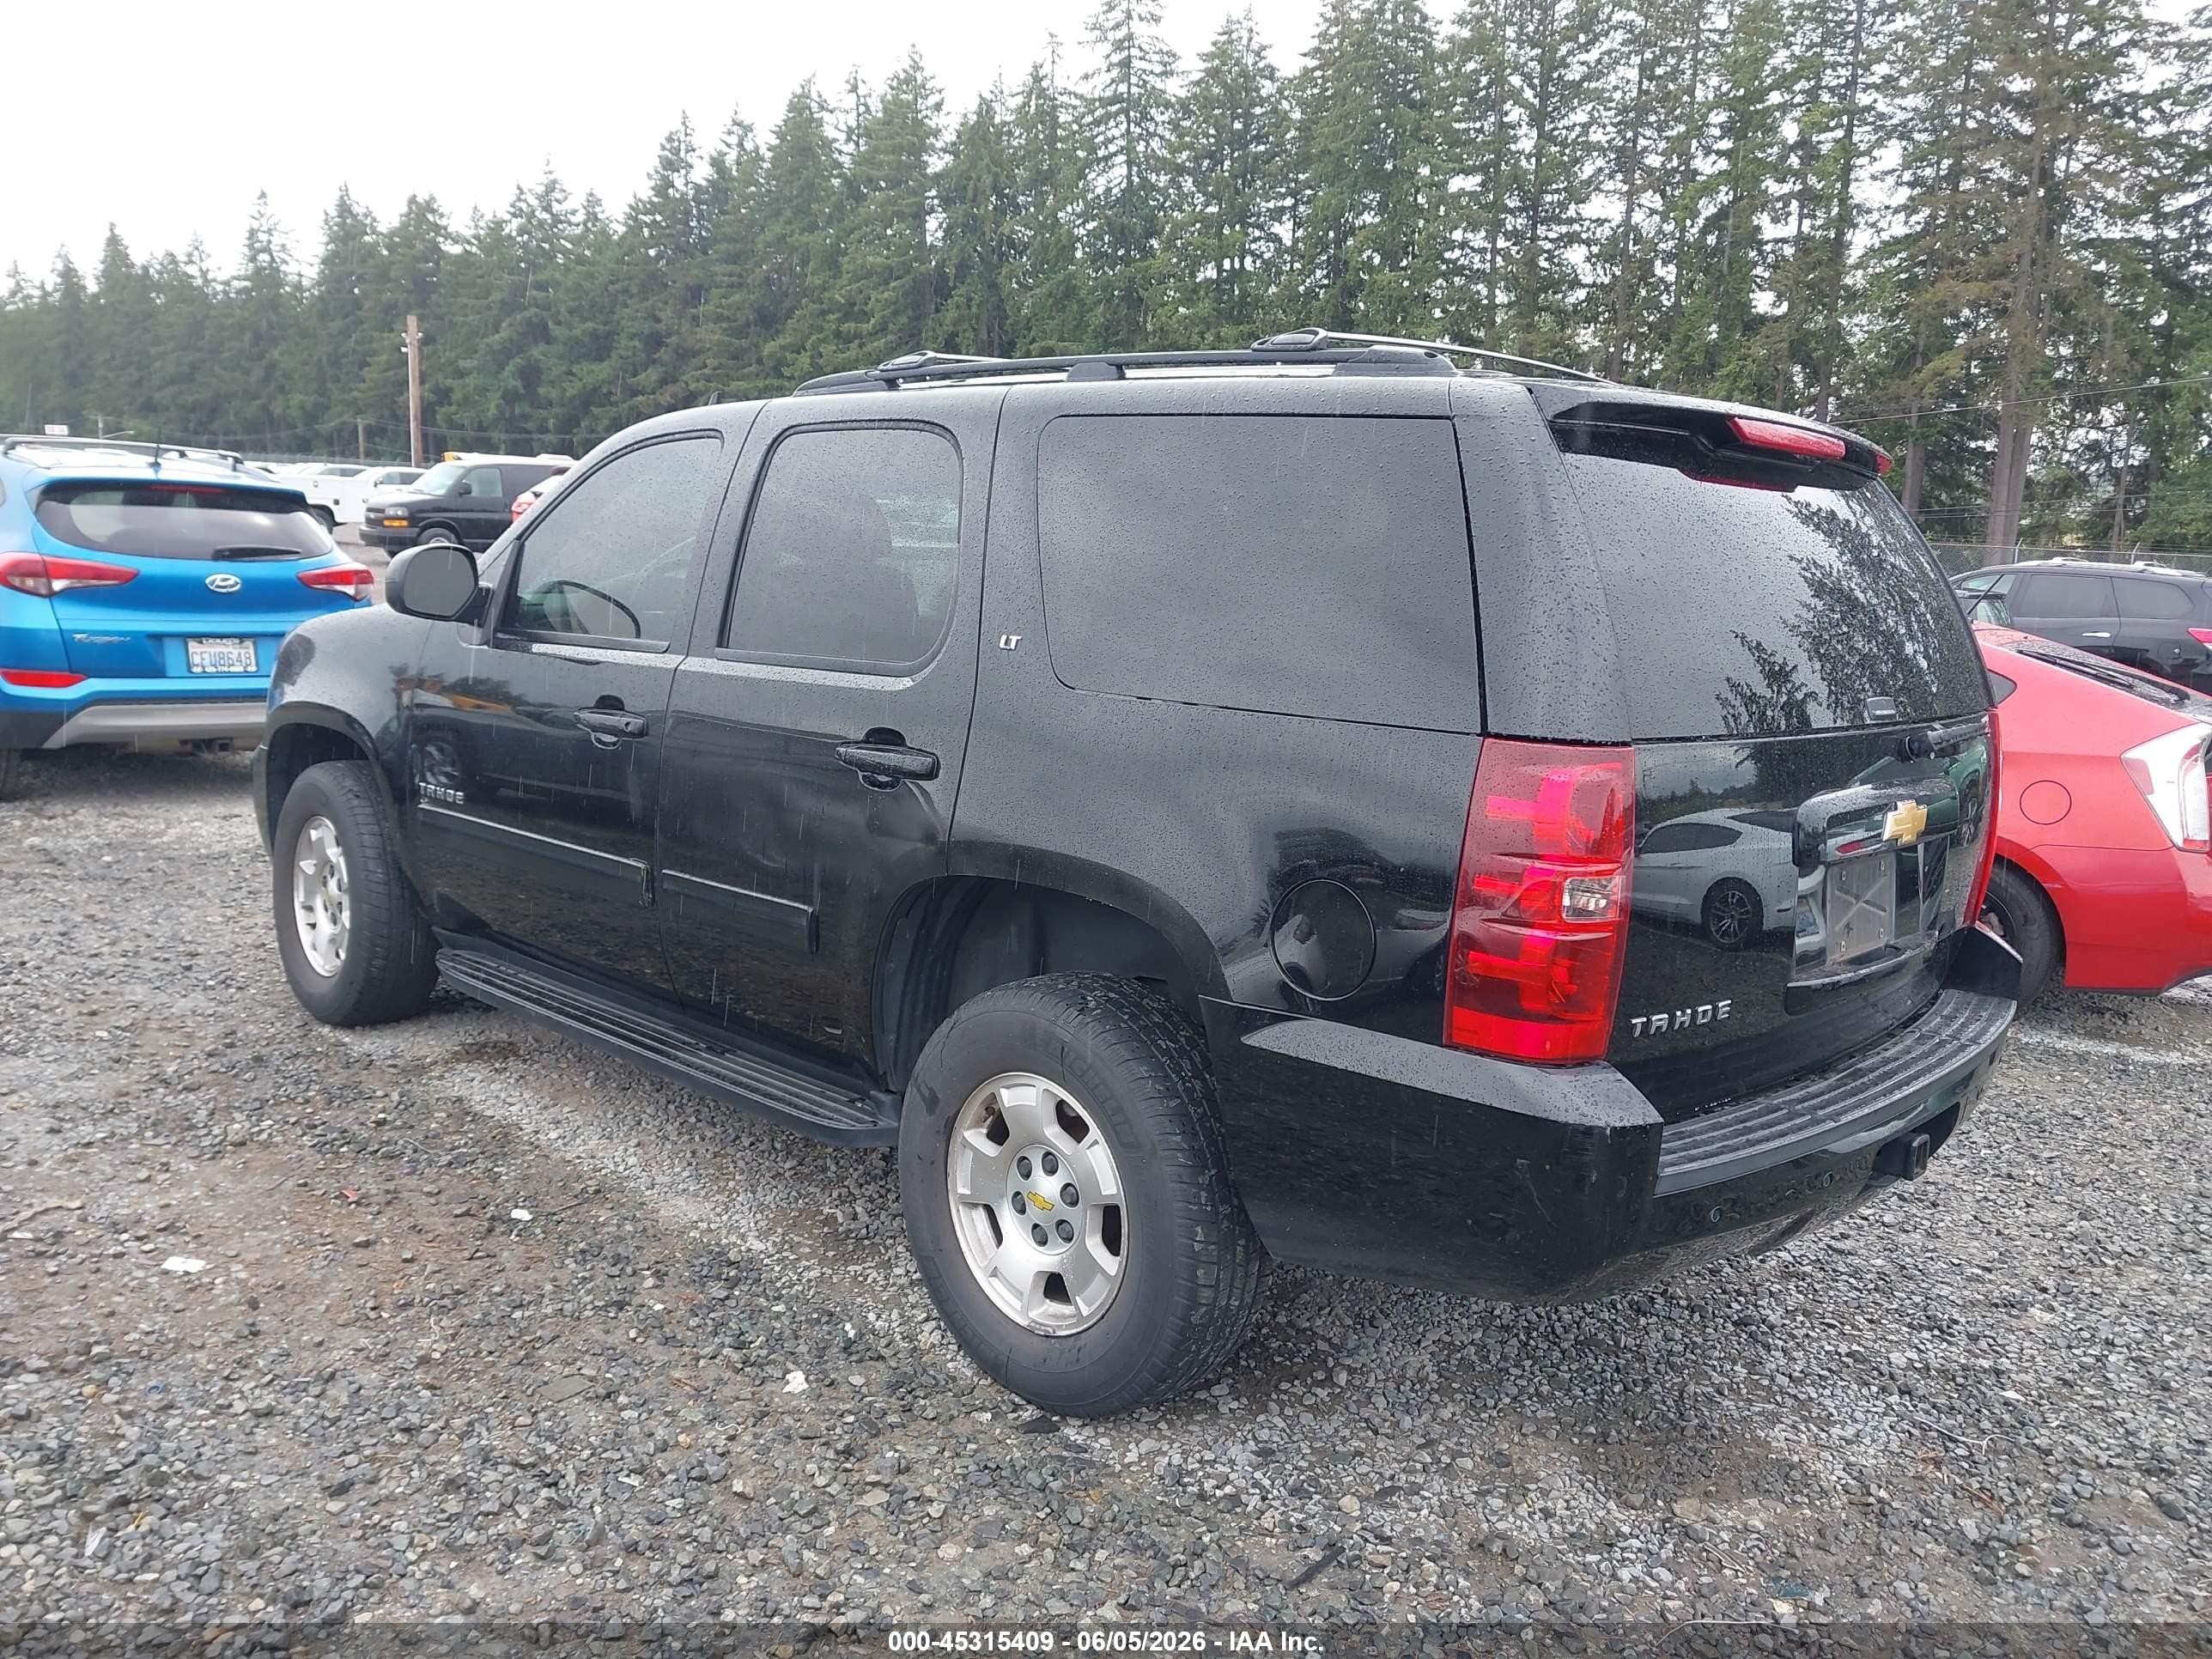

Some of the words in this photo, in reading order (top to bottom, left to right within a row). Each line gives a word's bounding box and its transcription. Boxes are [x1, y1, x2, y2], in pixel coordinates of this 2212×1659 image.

[999, 635, 1022, 650] LT
[418, 782, 464, 805] TAHOE
[1630, 1000, 1732, 1038] TAHOE
